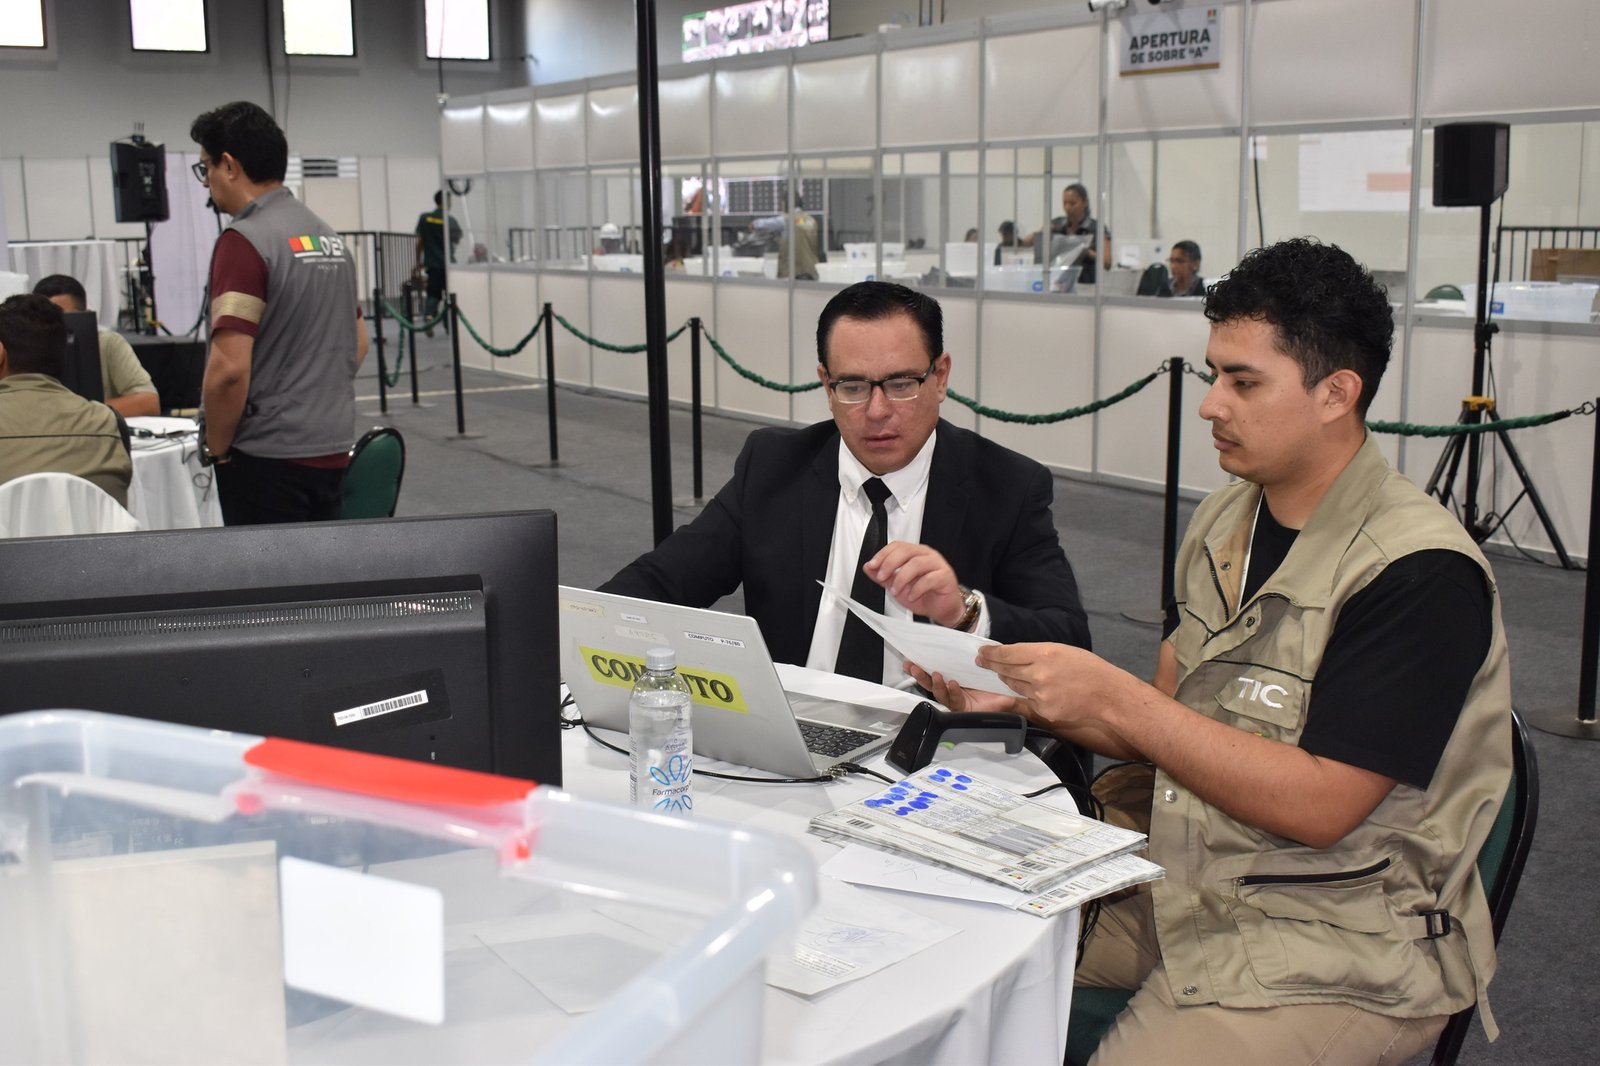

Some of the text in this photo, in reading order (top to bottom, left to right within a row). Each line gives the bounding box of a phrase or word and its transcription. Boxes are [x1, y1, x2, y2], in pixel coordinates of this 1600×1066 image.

[1129, 28, 1211, 51] APERTURA
[1130, 53, 1145, 64] DE
[1147, 48, 1186, 63] SOBRE
[688, 633, 715, 642] COMPUTO
[1238, 677, 1288, 708] TIC
